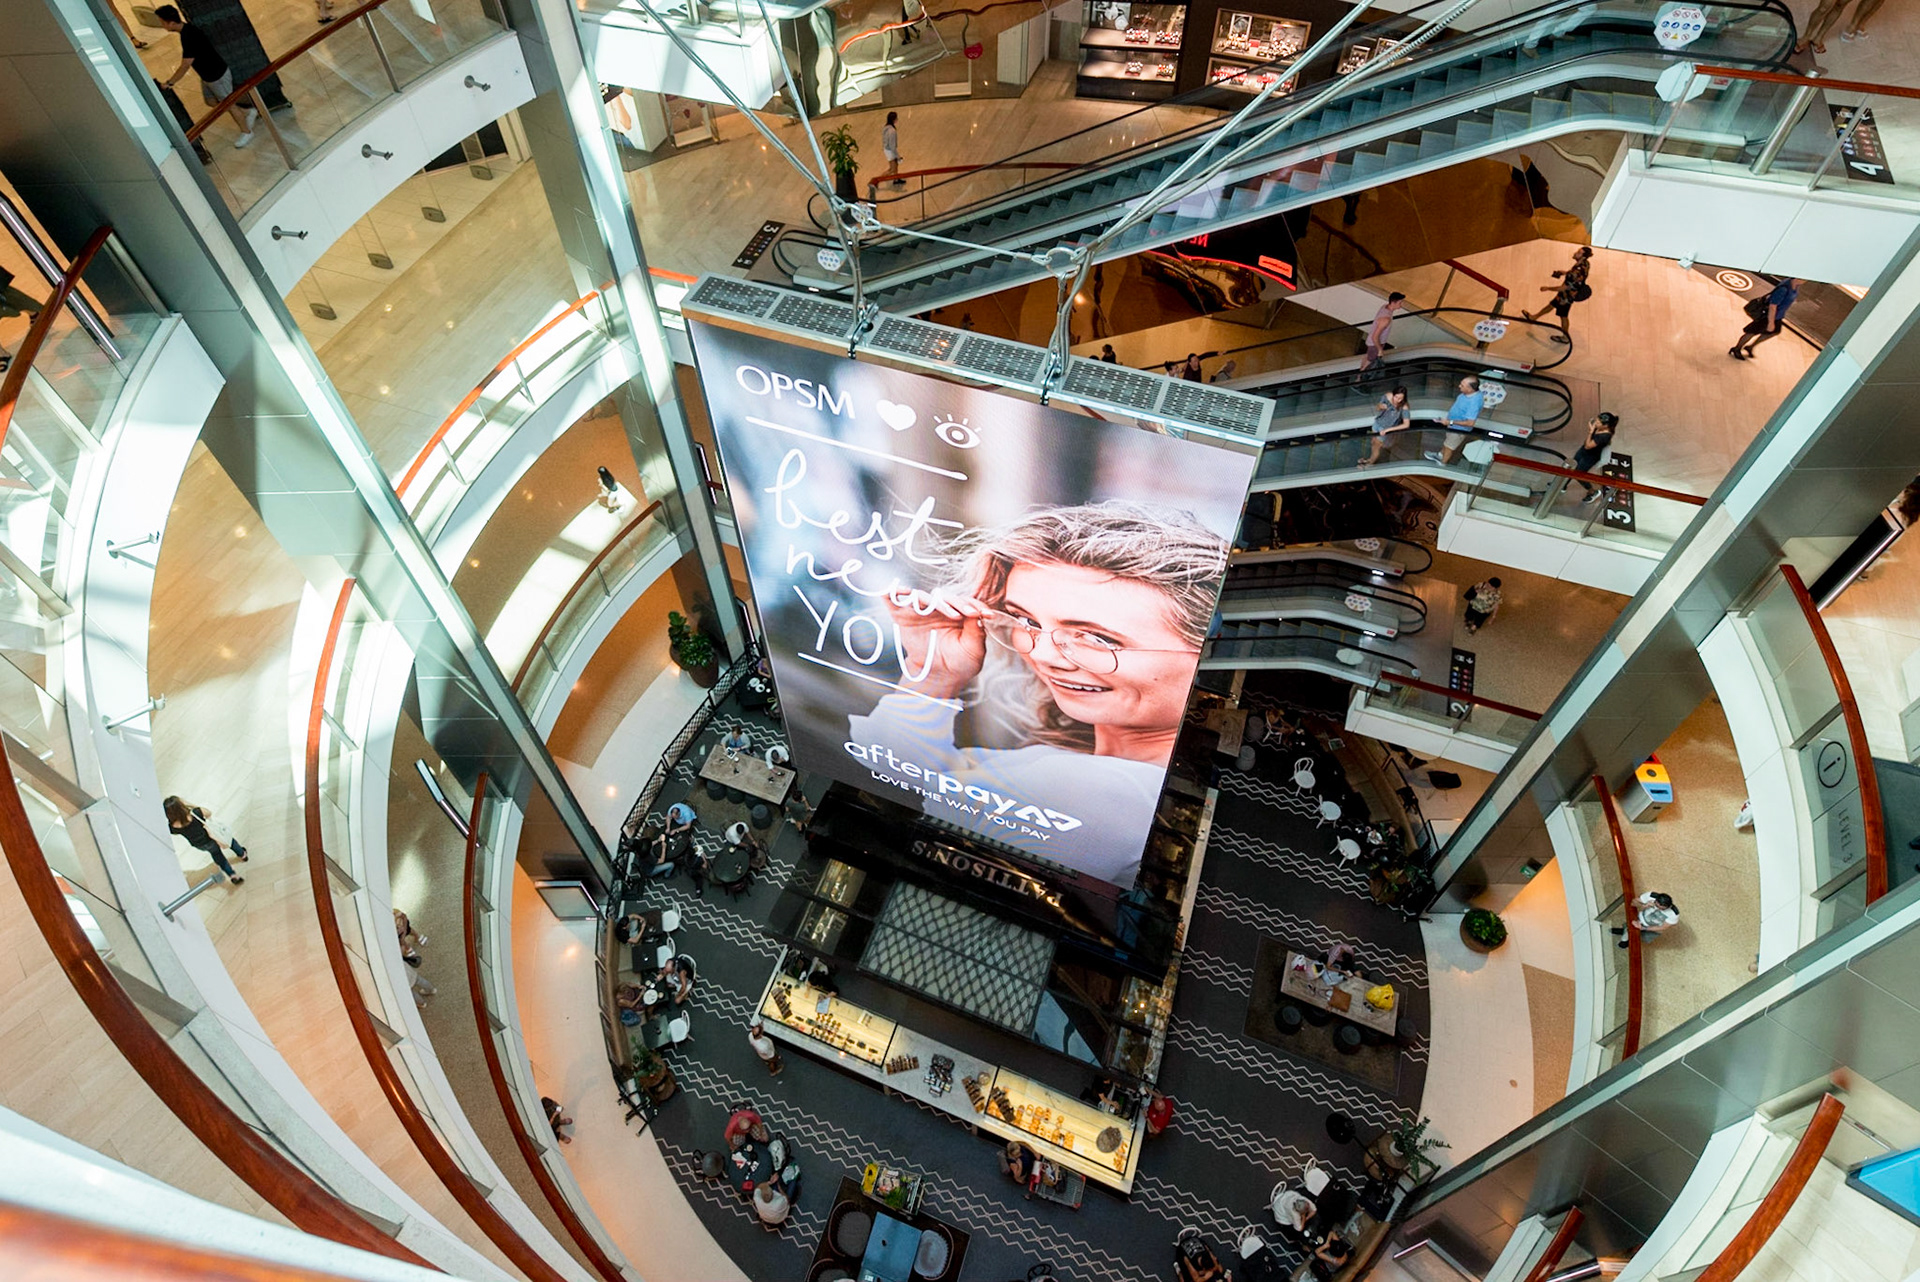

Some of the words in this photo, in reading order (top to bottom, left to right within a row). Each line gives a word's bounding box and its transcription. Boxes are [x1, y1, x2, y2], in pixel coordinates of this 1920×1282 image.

[1849, 161, 1884, 176] 4
[763, 224, 779, 234] 3
[735, 364, 856, 419] OPSM
[764, 448, 965, 565] best
[1606, 508, 1632, 524] 3
[786, 544, 943, 616] new
[792, 585, 938, 683] YOU
[1450, 702, 1469, 714] 2
[843, 741, 1018, 815] afterpay
[871, 770, 910, 791] LOVE
[913, 785, 942, 803] THE
[945, 797, 980, 816] WAY
[983, 811, 1017, 830] YOU
[1021, 825, 1051, 842] PAY
[1838, 808, 1853, 852] LEVEL
[1843, 853, 1854, 864] 3
